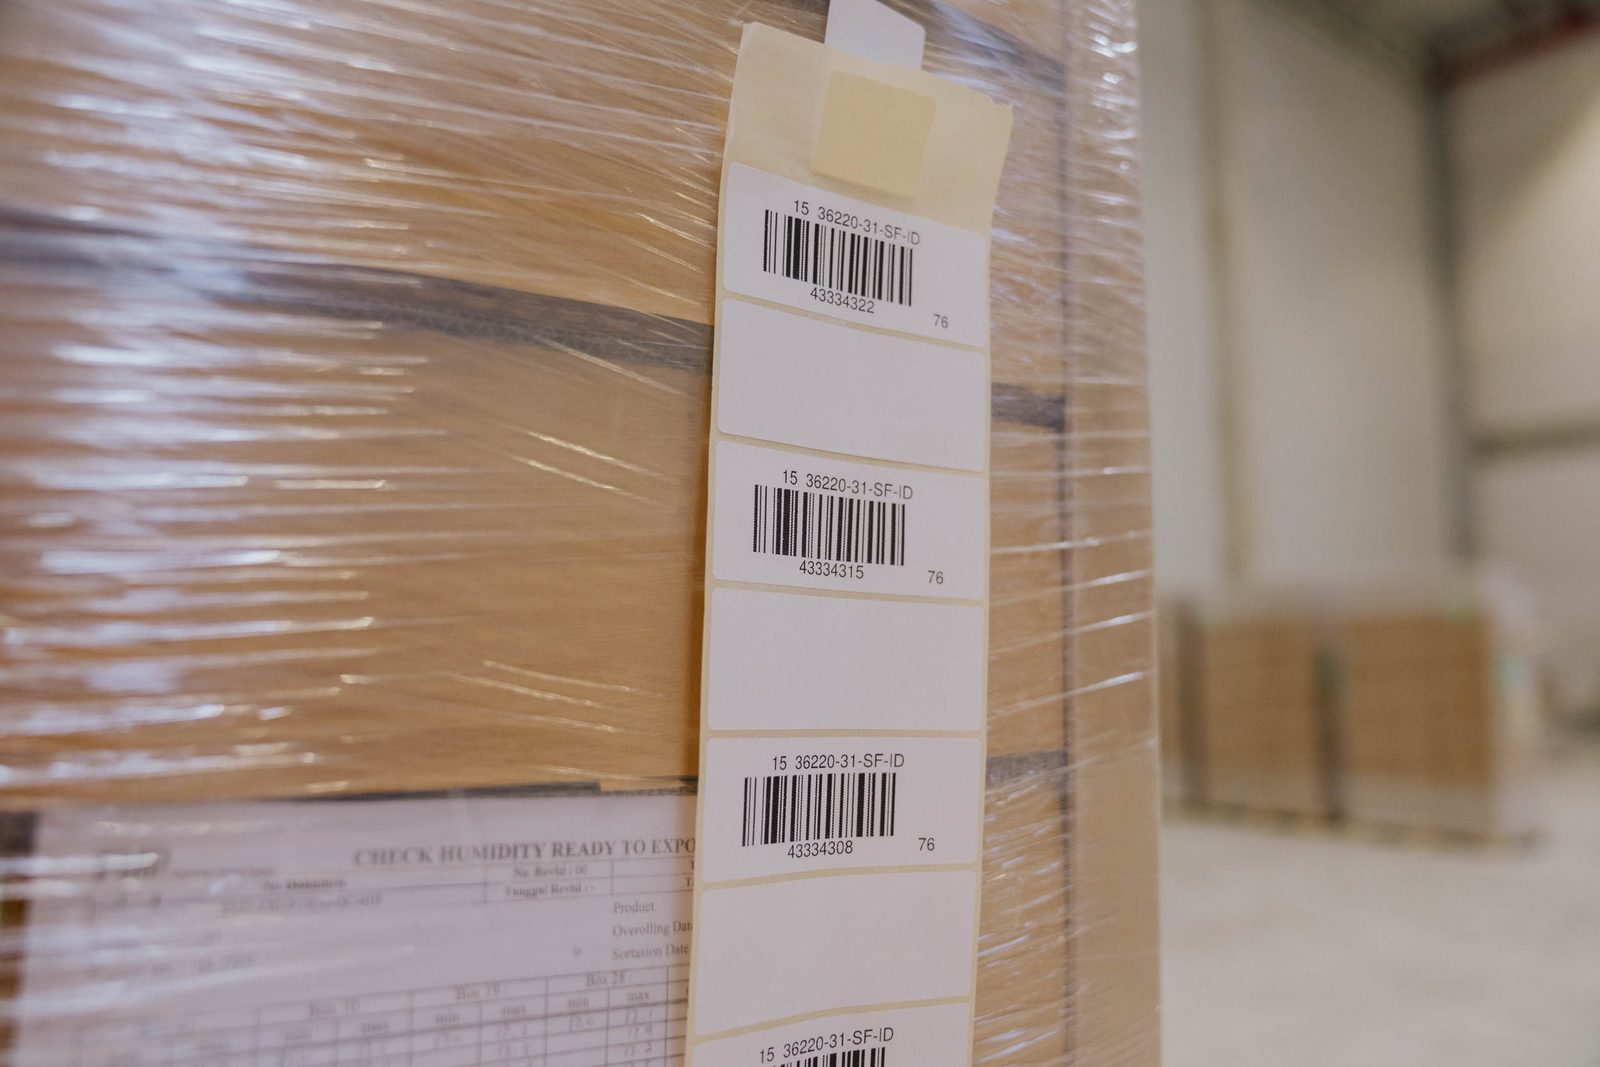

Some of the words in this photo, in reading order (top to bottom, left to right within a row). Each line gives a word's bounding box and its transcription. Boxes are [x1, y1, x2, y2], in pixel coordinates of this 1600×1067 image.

[794, 199, 810, 216] 15
[817, 206, 921, 246] 36220-31-SF-ID
[810, 286, 875, 314] 43334322
[933, 313, 949, 329] 76
[782, 469, 798, 486] 15
[805, 473, 913, 500] 36220-31-SF-ID
[799, 559, 865, 580] 43334315
[927, 570, 944, 585] 76
[772, 755, 787, 771] 15
[794, 752, 905, 770] 36220-31-SF-ID
[352, 846, 433, 865] CHECK
[440, 841, 545, 862] HUMIDITY
[552, 839, 615, 858] READY
[622, 839, 647, 856] TO
[787, 840, 854, 859] 43334308
[917, 837, 935, 852] 76
[613, 901, 656, 914] Product
[612, 922, 670, 938] Overolling
[611, 945, 663, 960] Sortasion
[665, 943, 690, 957] Date
[759, 1046, 775, 1063] 15
[783, 1027, 894, 1059] 36220-31-SF-ID
